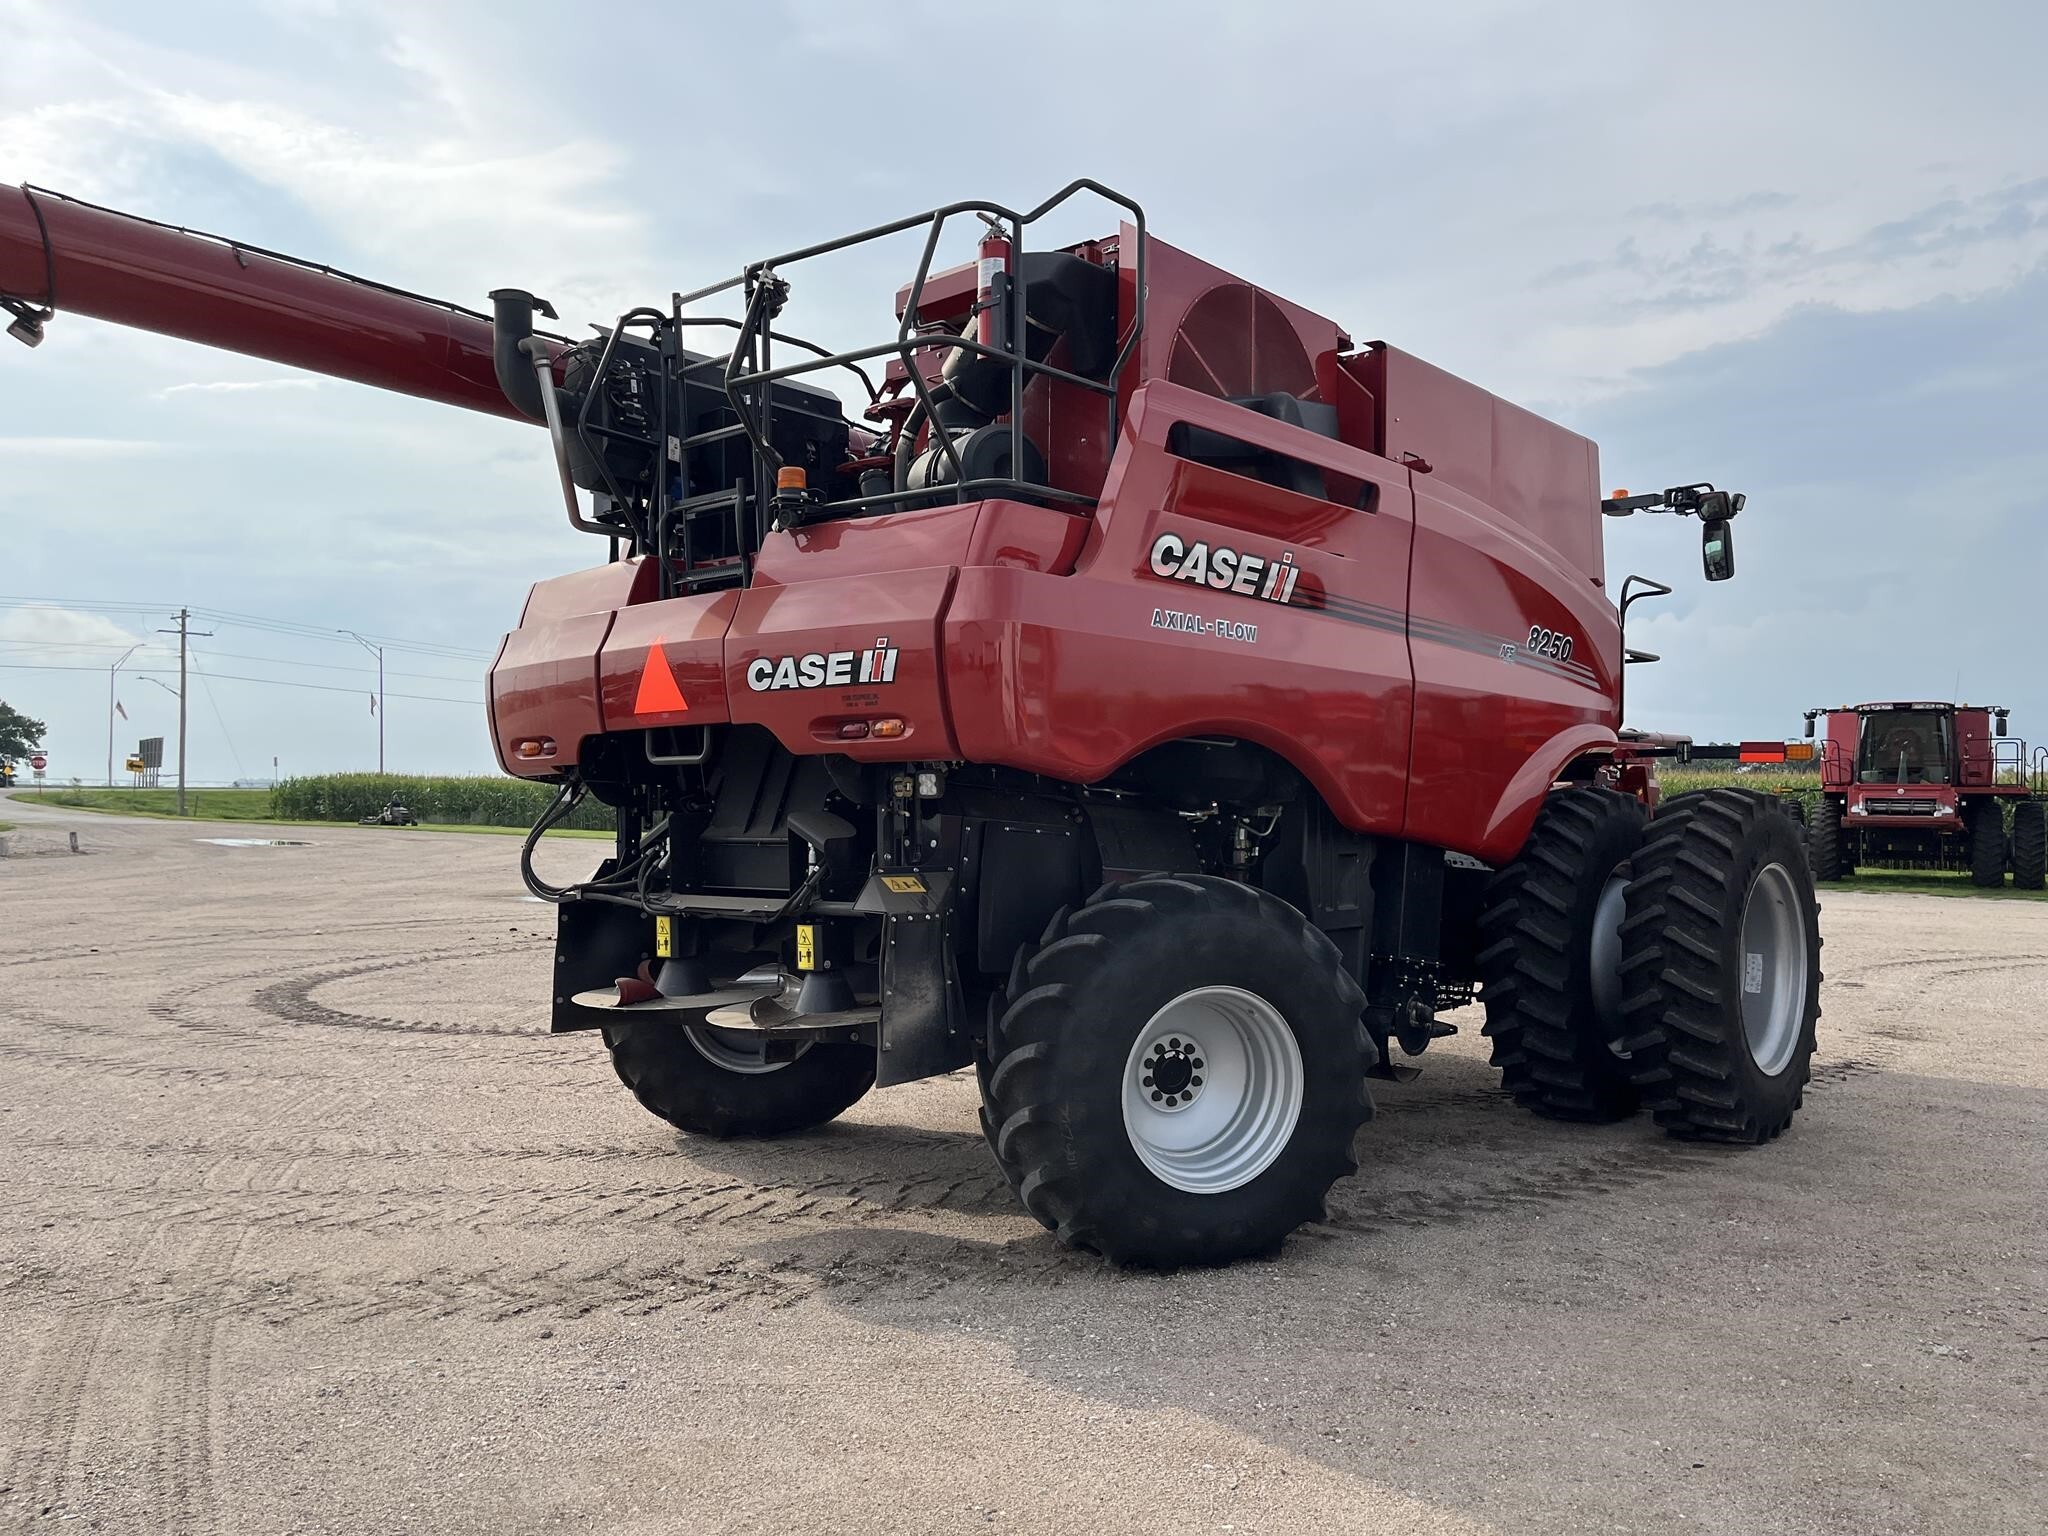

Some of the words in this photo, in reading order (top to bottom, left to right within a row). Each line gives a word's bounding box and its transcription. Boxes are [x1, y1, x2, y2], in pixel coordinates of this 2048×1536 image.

[1150, 533, 1265, 596] CASE
[1150, 608, 1258, 644] AXIAL-FLOW
[1526, 624, 1574, 664] 8250
[746, 650, 855, 692] CASE
